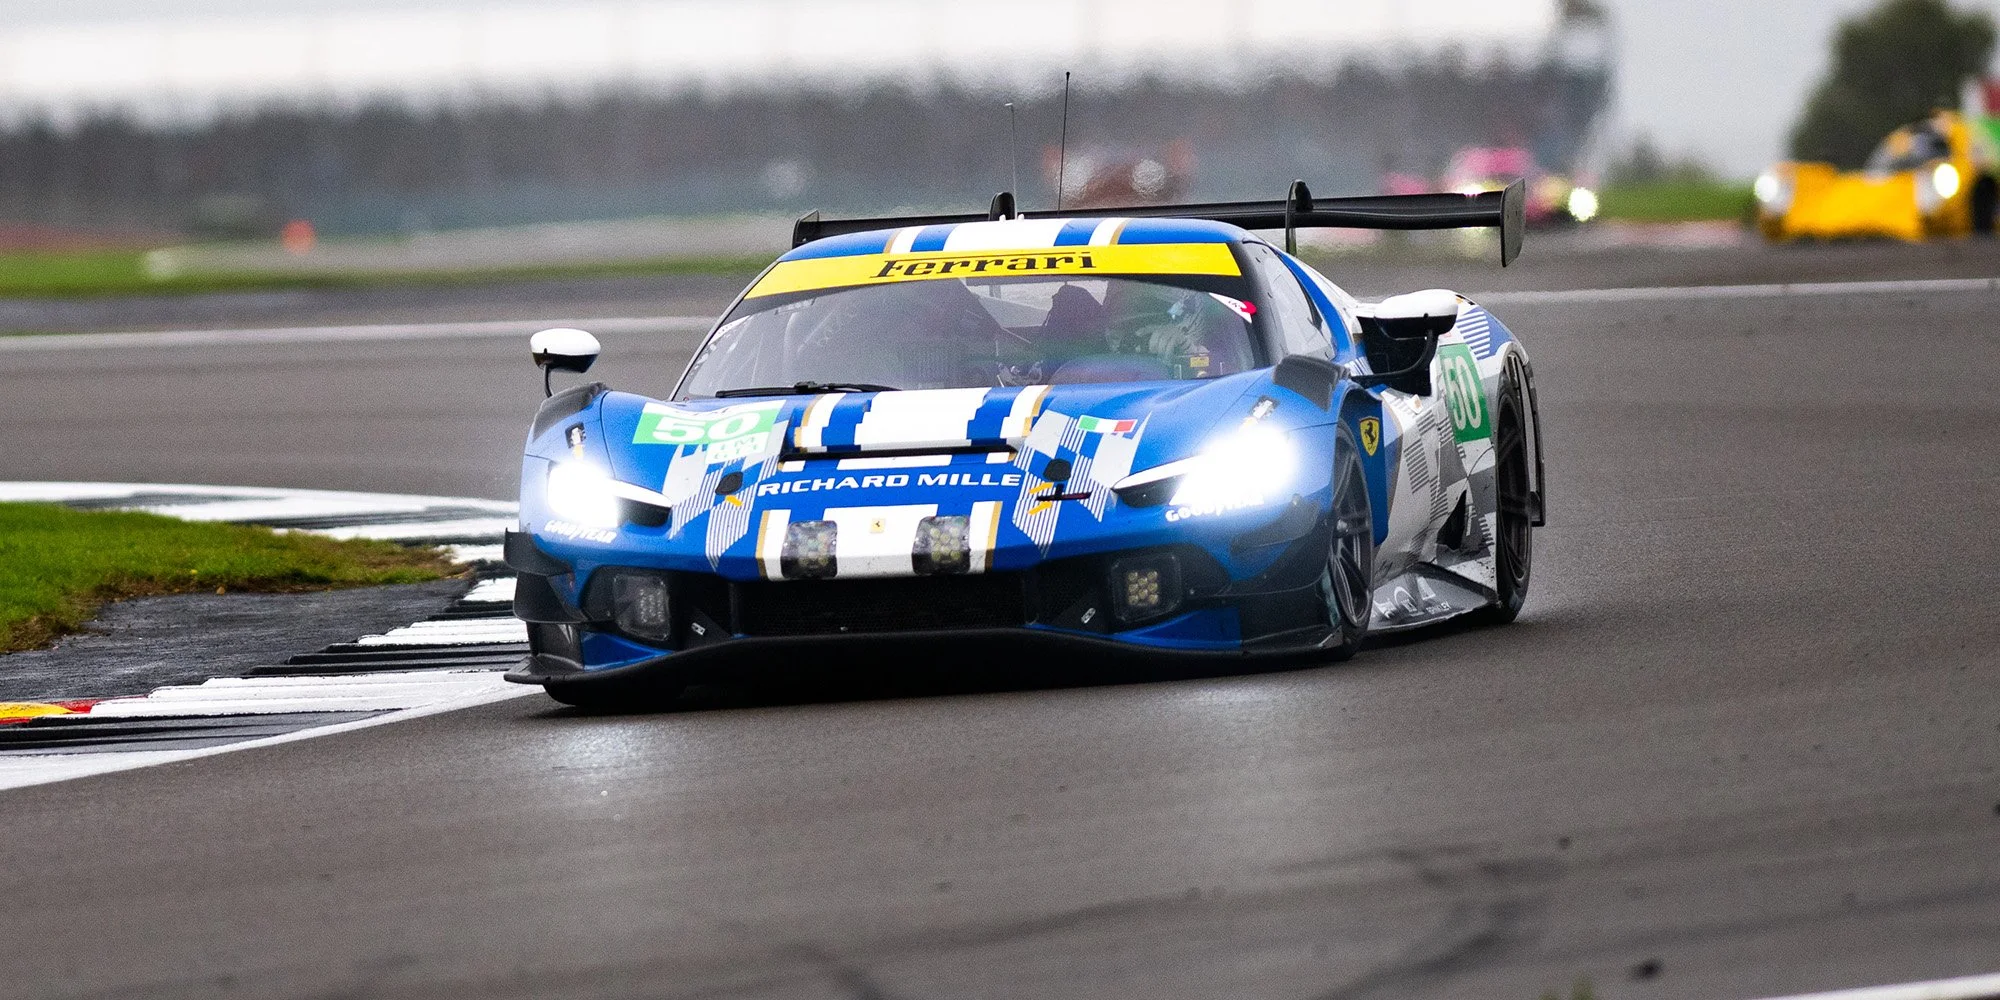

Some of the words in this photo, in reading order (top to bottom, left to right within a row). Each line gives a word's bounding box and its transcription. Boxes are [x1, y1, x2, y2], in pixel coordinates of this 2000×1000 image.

[870, 252, 1096, 278] Ferrari
[1444, 356, 1481, 430] 50
[652, 412, 760, 441] 50
[757, 475, 910, 496] RICHARD
[917, 473, 1021, 486] MILLE
